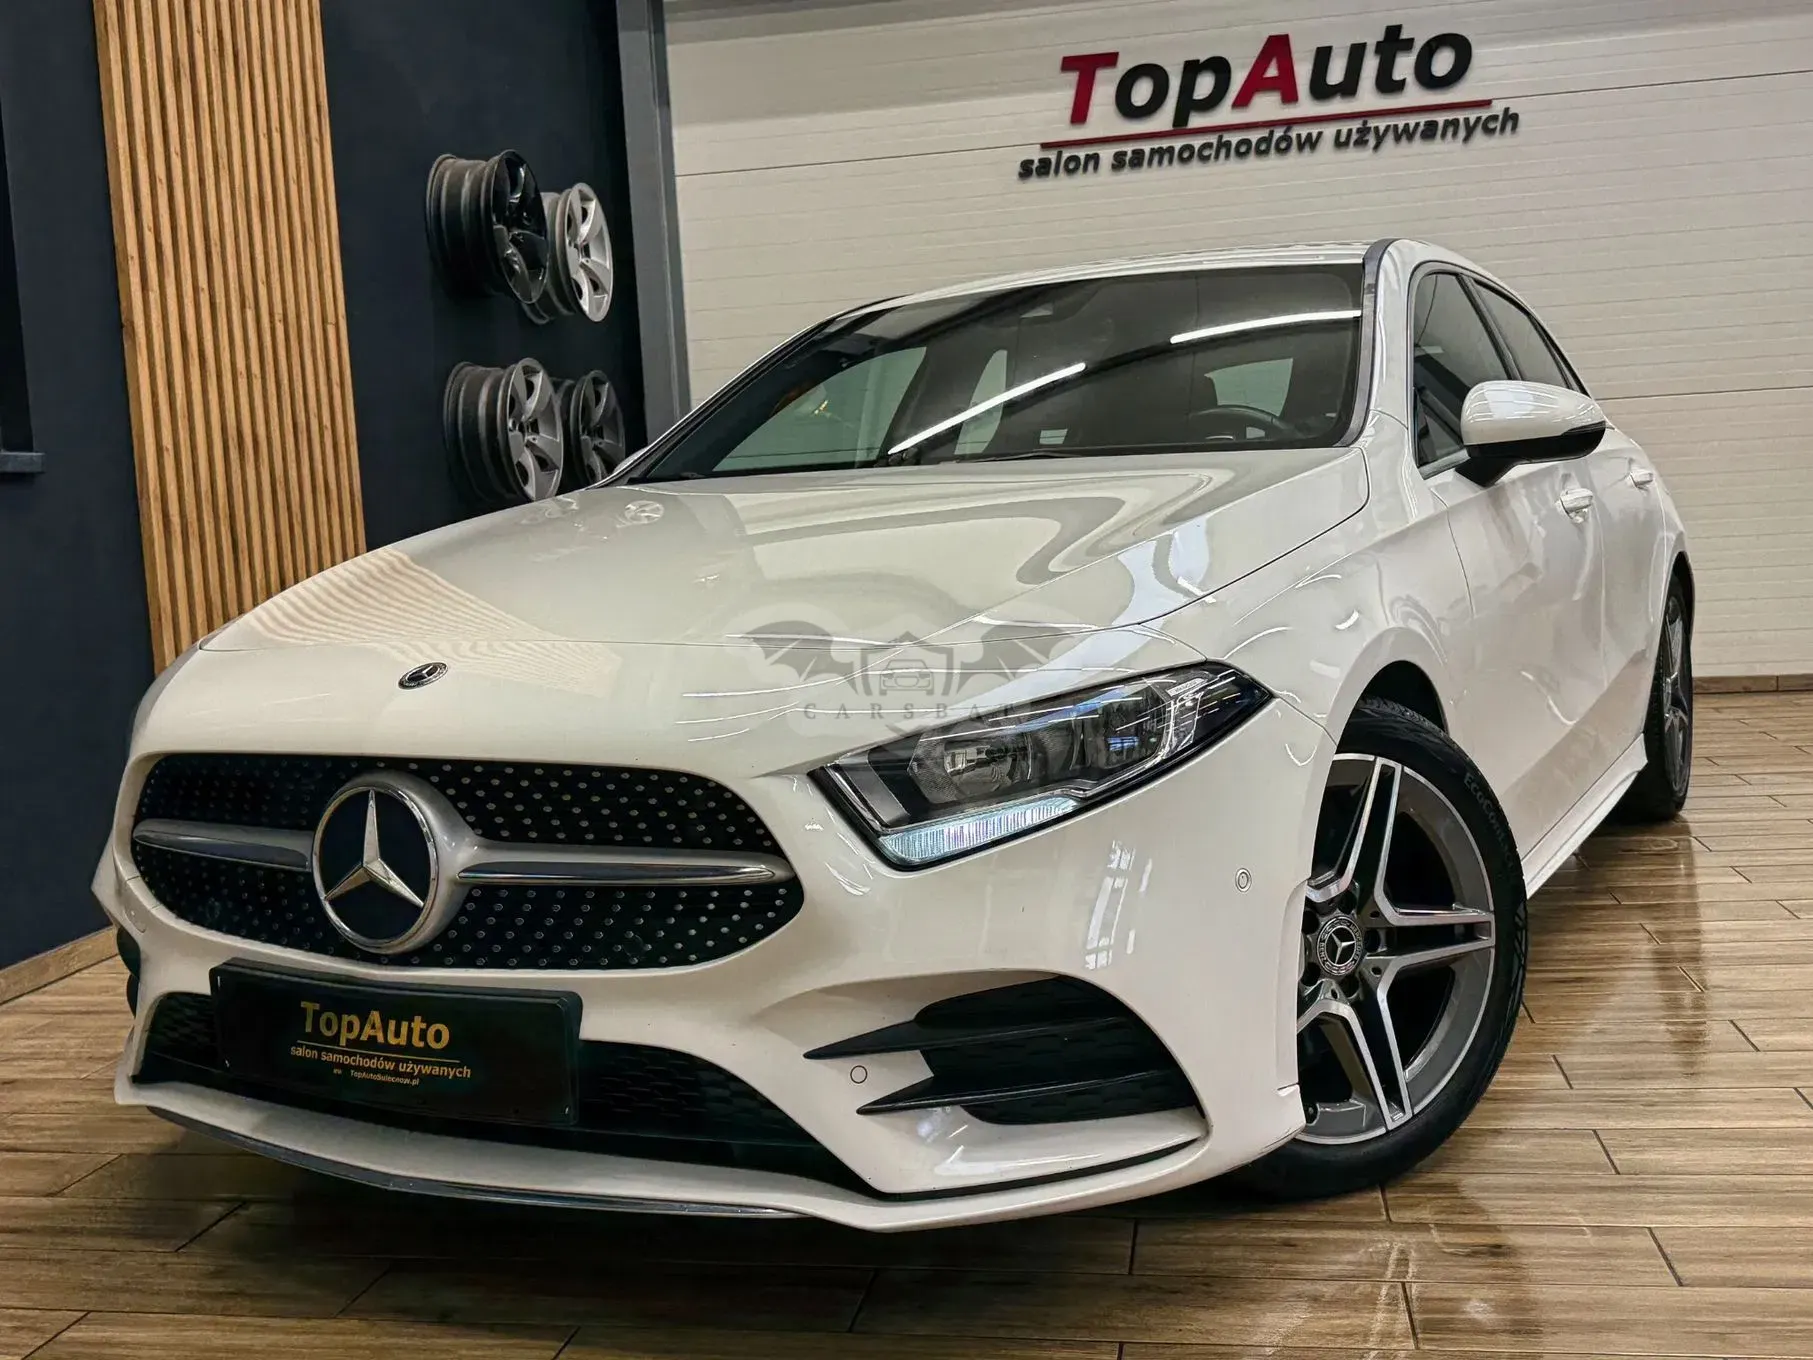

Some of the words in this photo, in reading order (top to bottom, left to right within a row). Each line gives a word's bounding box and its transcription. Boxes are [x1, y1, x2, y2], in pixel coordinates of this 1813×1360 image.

[1061, 24, 1473, 127] TopAuto
[1018, 150, 1100, 179] salon
[1111, 126, 1323, 171] samochodów
[1333, 107, 1519, 153] używanych
[300, 1001, 450, 1050] TopAuto
[290, 1045, 318, 1059] salon
[320, 1050, 395, 1071] samochodów
[398, 1060, 471, 1079] używanych
